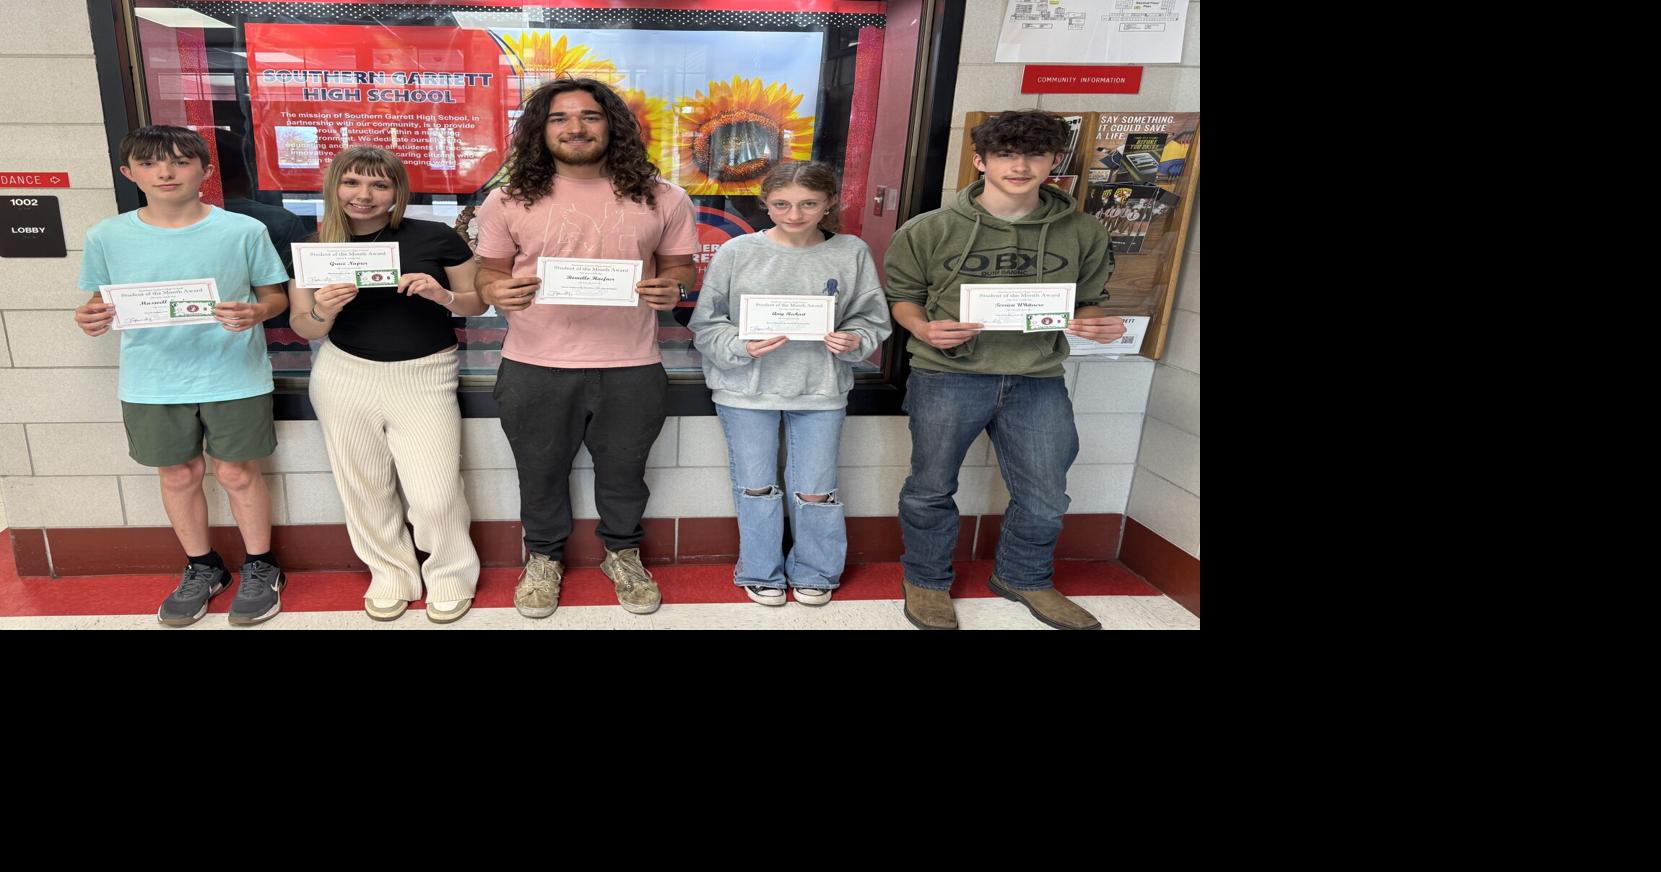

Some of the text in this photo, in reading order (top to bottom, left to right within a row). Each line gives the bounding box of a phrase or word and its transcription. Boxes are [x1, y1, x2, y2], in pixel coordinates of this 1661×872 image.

[263, 69, 493, 87] SOUTHERN GARRETT
[303, 87, 457, 104] HIGH SCHOOL
[438, 114, 470, 122] School,
[1100, 116, 1175, 124] SAY SOMETHING.
[1098, 124, 1167, 132] IT COULD SAVE
[1, 175, 42, 185] DANCE
[10, 198, 39, 206] 1002
